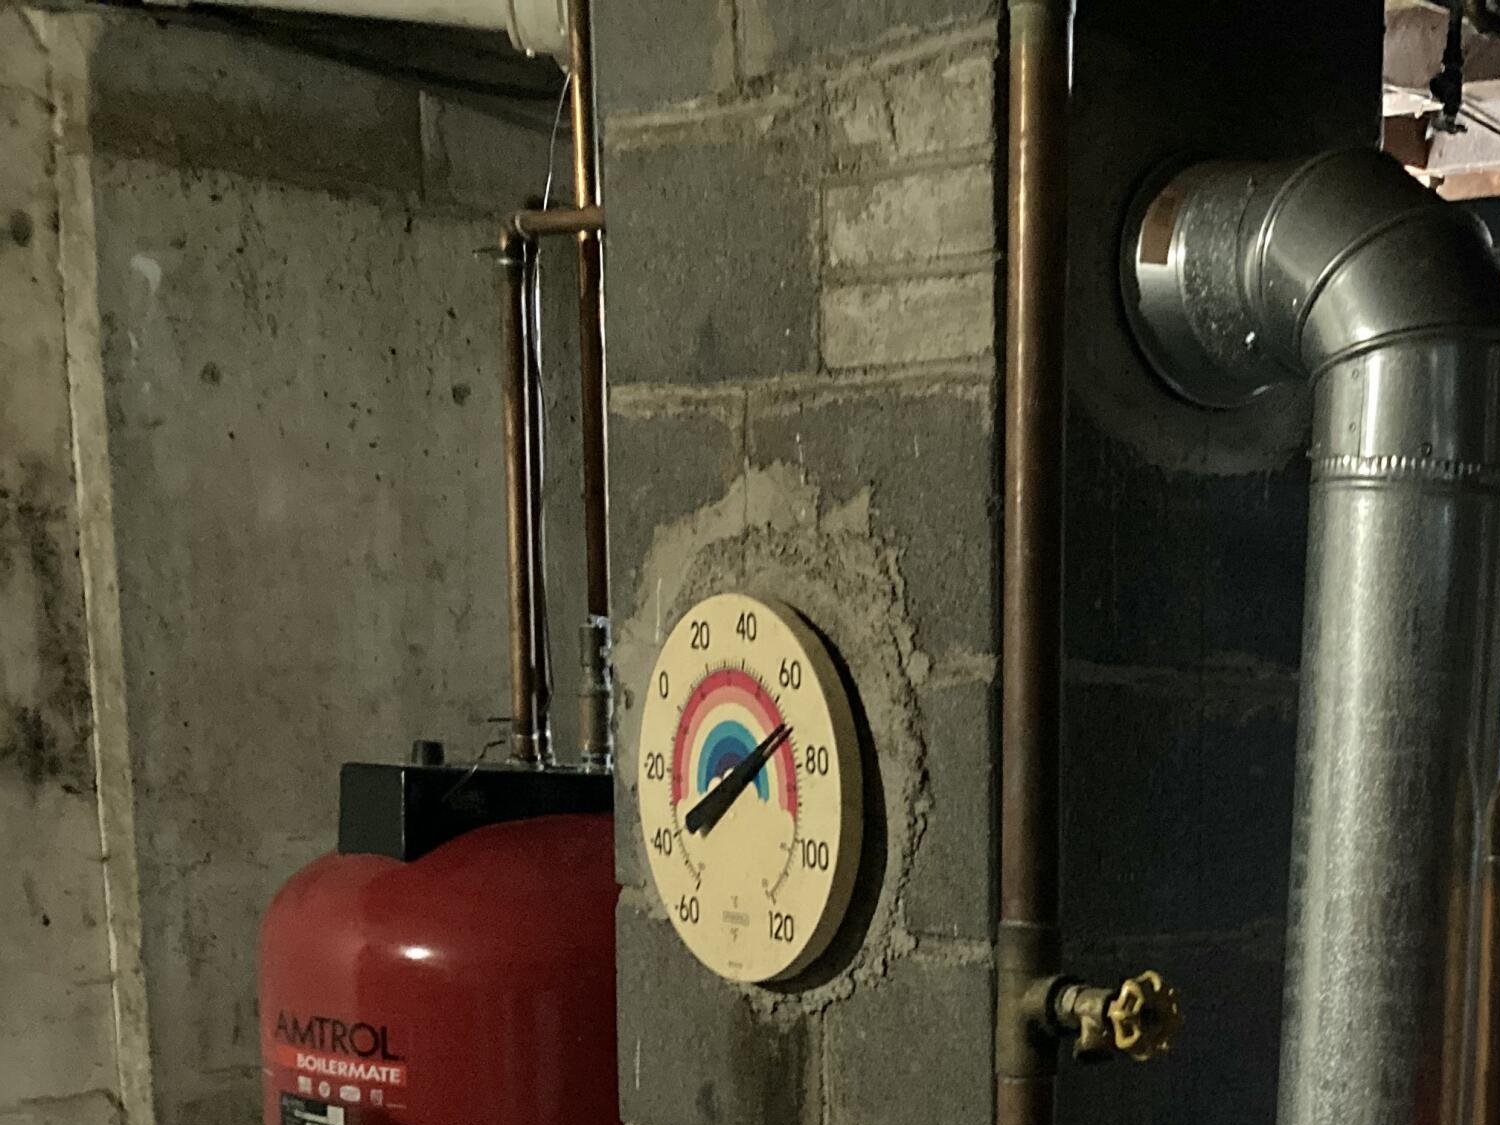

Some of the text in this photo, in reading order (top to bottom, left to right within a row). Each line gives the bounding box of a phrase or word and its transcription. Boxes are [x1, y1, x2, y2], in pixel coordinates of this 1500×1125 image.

[690, 621, 710, 651] 20
[736, 611, 758, 643] 40
[659, 670, 669, 700] 0
[779, 658, 802, 690] 60
[805, 746, 829, 776] 80
[800, 839, 829, 871] 100
[768, 910, 795, 943] 120
[275, 1009, 401, 1061] AMTROL
[296, 1053, 401, 1085] BOILERMATE
